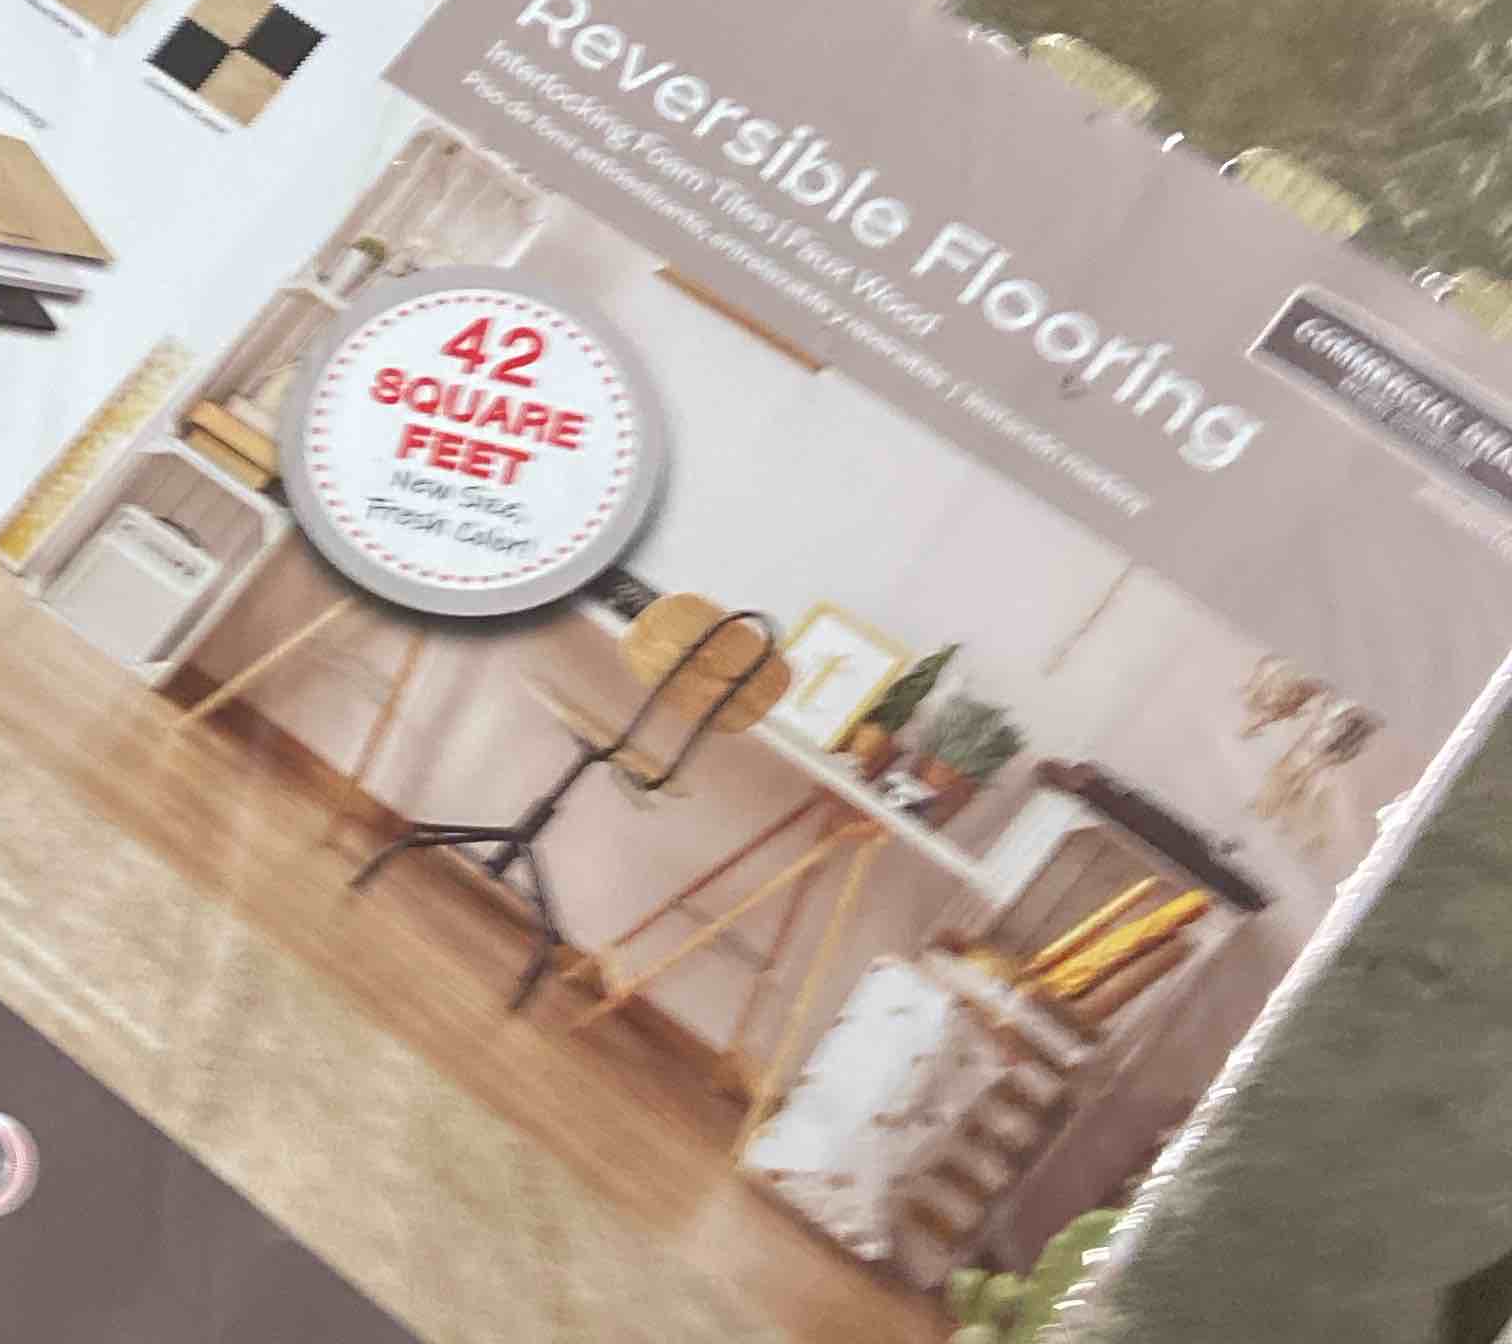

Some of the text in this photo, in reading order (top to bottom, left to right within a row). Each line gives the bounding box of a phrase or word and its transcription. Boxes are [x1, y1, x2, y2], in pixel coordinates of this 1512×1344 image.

[848, 268, 947, 339] Wood
[443, 316, 543, 388] 42
[913, 221, 1263, 471] Flooring
[371, 367, 586, 449] SQUARE
[397, 422, 532, 485] FEET
